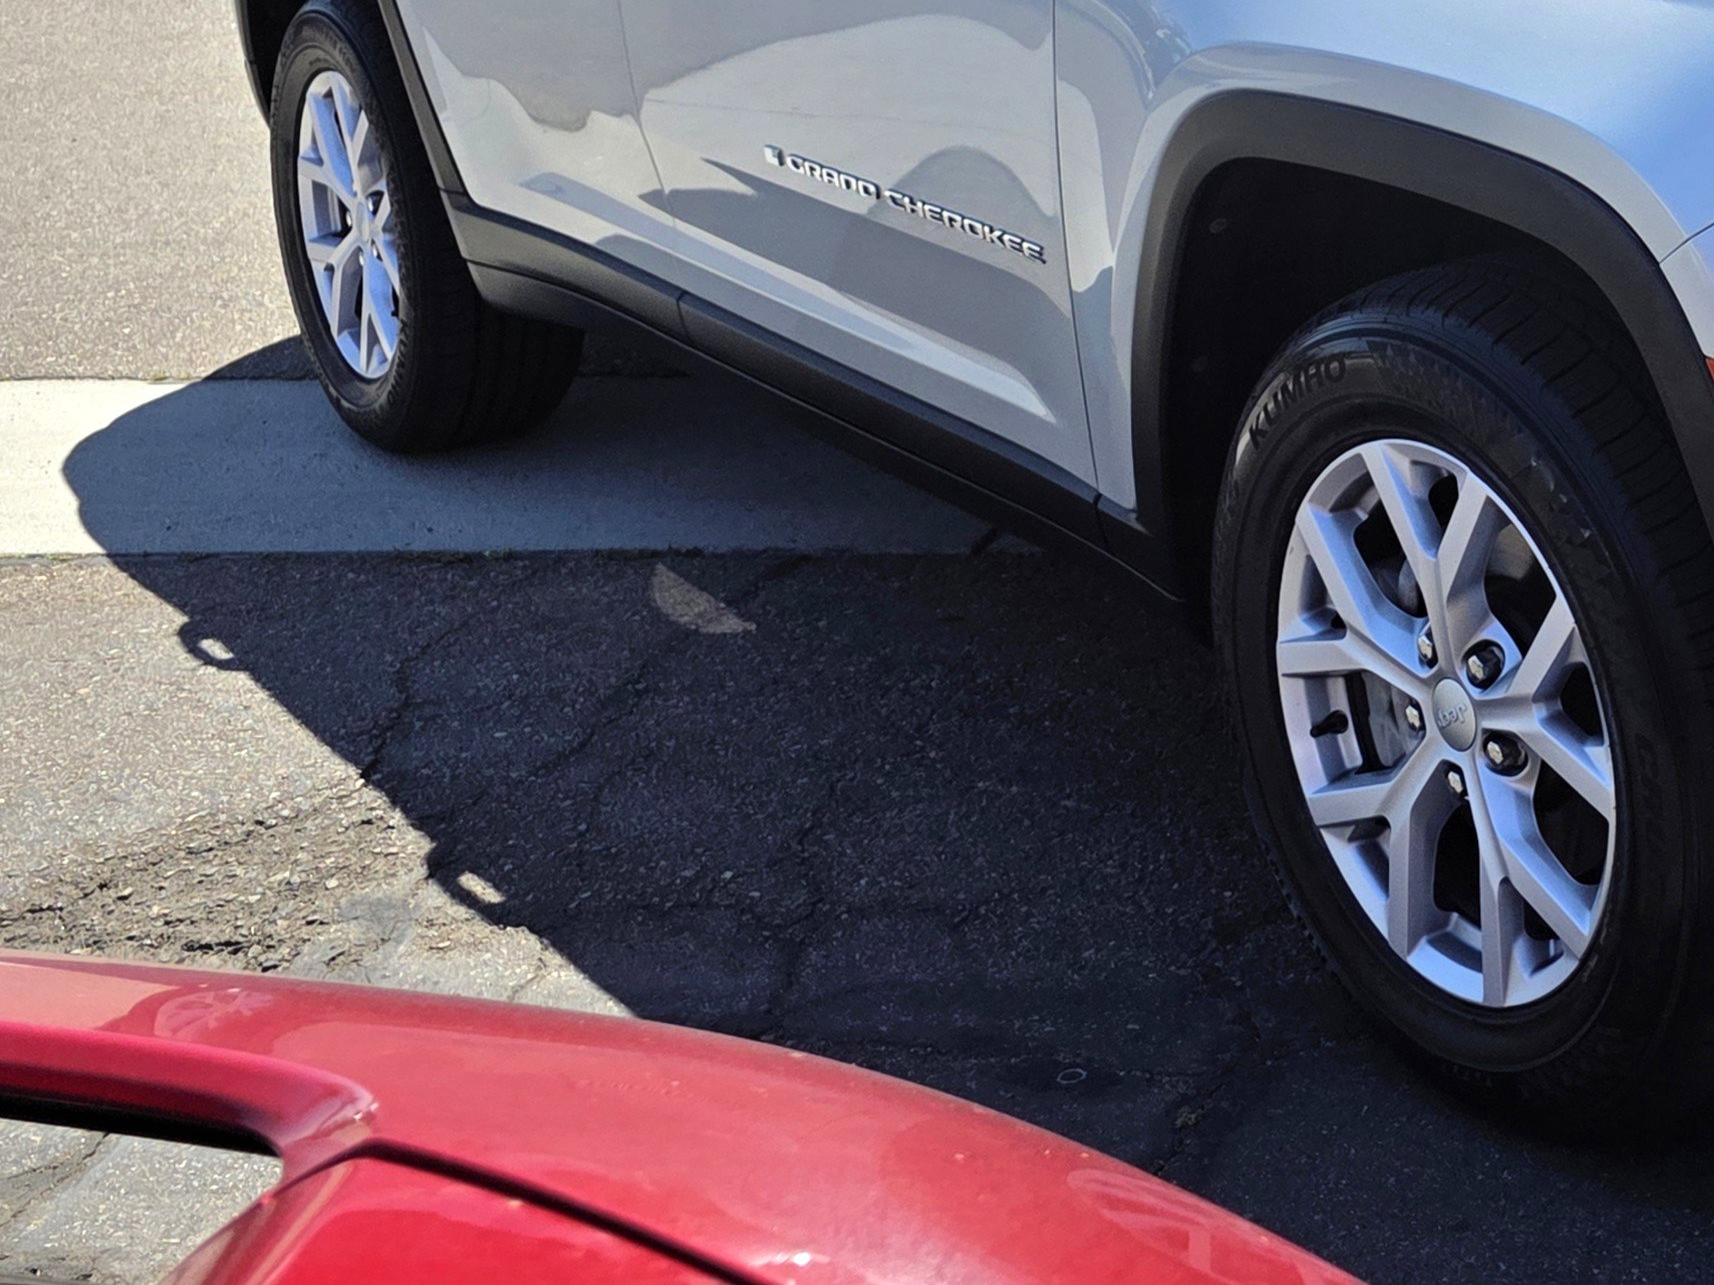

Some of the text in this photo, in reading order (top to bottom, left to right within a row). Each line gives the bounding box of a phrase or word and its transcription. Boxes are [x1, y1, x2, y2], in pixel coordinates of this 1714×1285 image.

[785, 153, 1047, 264] GRAND CHEROKEE
[1249, 354, 1348, 451] KUMHO
